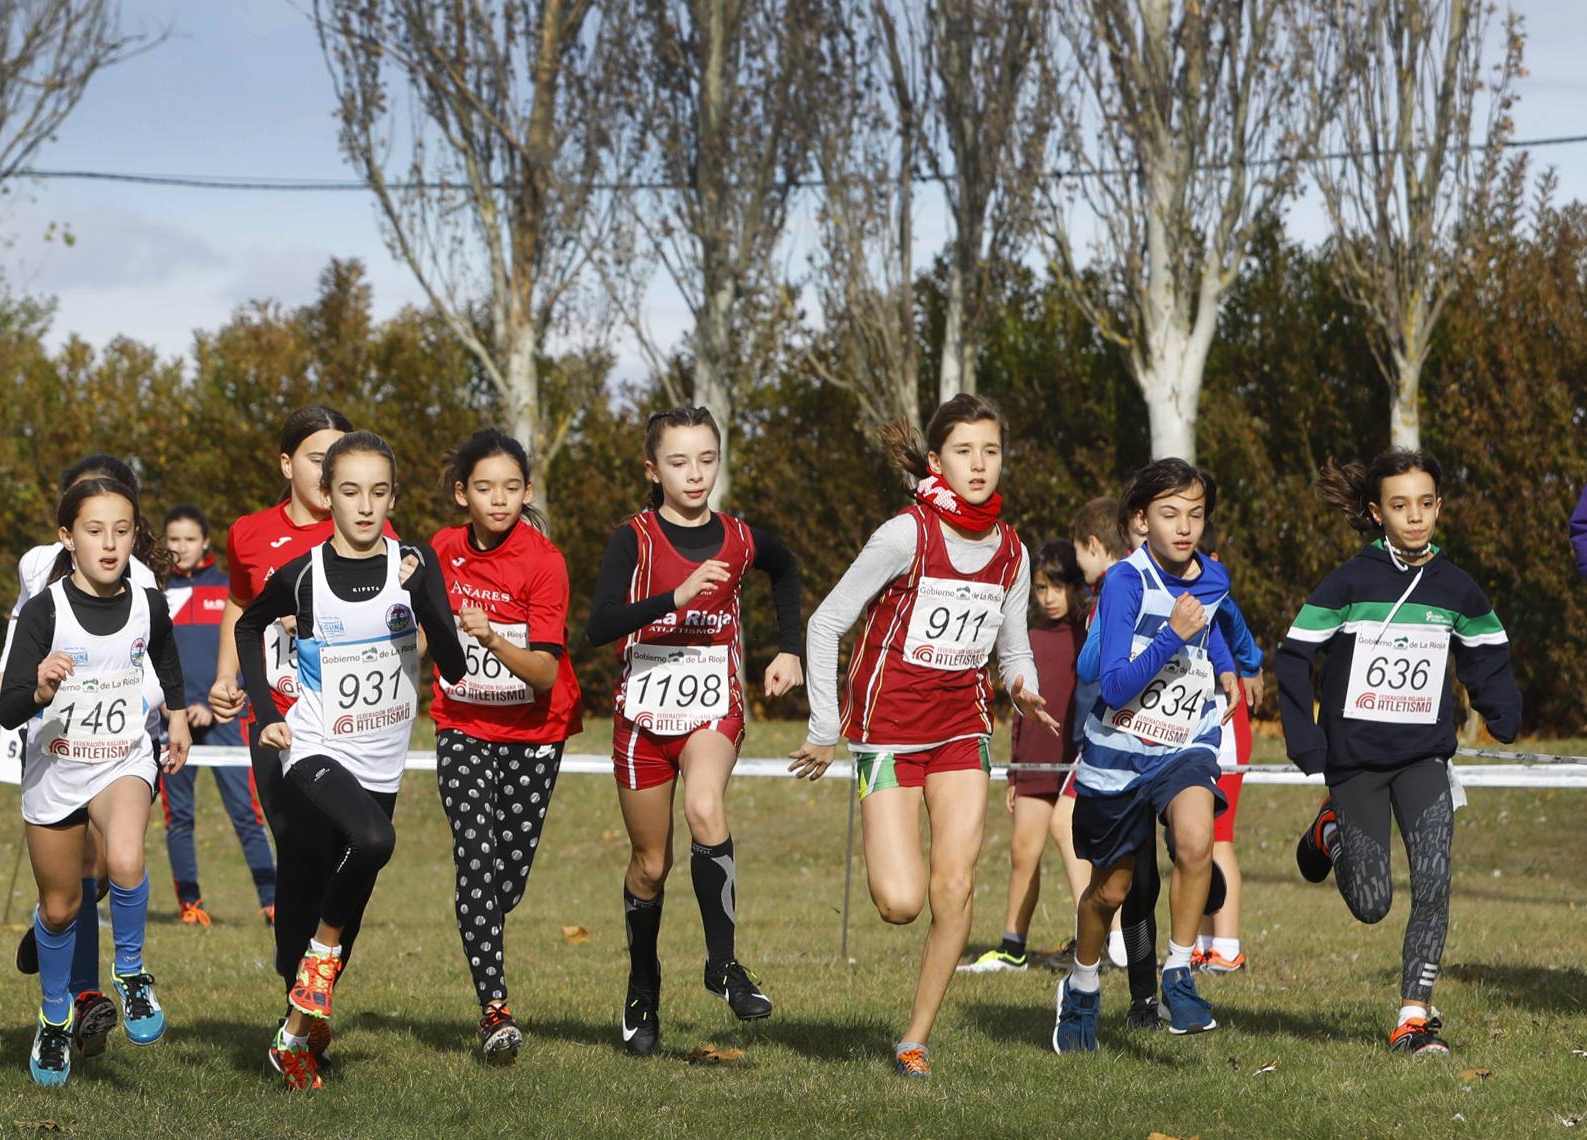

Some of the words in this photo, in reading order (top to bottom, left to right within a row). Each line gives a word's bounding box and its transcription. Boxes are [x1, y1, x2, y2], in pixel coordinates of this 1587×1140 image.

[451, 580, 510, 602] AÑARES
[920, 586, 954, 597] Gobierno
[462, 599, 496, 613] RIOJA
[648, 625, 716, 634] ATLETISMO
[685, 609, 732, 633] Rioja
[925, 606, 988, 642] 911
[322, 654, 360, 664] Gobierno
[379, 650, 389, 659] de
[390, 648, 401, 657] La
[1429, 642, 1446, 651] Rioja
[634, 651, 667, 663] Gobierno
[686, 654, 695, 663] de
[697, 654, 707, 663] La
[708, 655, 726, 665] Rioja
[1180, 666, 1187, 674] de
[1188, 667, 1196, 675] La
[1366, 656, 1431, 691] 636
[112, 680, 121, 688] La
[123, 677, 140, 687] Rioja
[338, 664, 402, 709] 931
[636, 672, 721, 707] 1198
[467, 686, 526, 702] ATLETISMO
[1139, 679, 1203, 720] 634
[1377, 700, 1432, 713] ATLETISMO
[59, 698, 127, 735] 146
[356, 707, 410, 733] ATLETISMO
[1133, 720, 1189, 744] ATLETISMO
